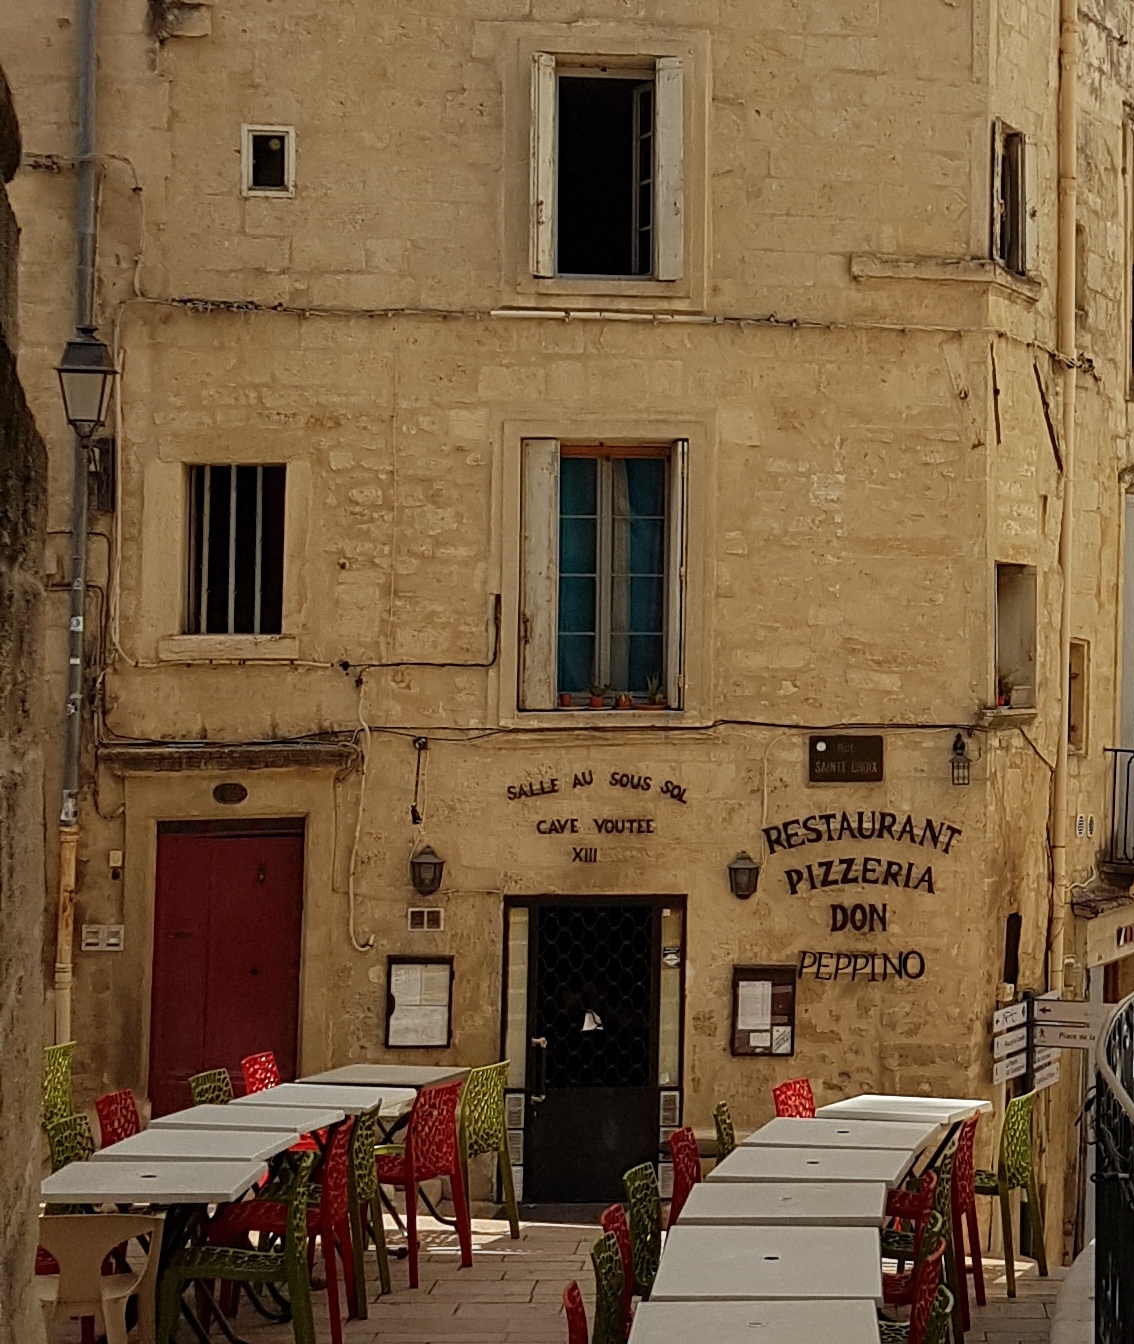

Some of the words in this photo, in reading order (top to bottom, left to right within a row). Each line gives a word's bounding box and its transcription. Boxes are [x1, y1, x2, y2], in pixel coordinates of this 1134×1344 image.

[814, 760, 847, 774] SAINTE
[507, 778, 560, 801] SALLE
[572, 770, 594, 789] AU
[608, 771, 653, 792] SOUS
[660, 780, 688, 805] SOL
[536, 818, 579, 835] CAVE
[593, 818, 655, 834] VOUTEE
[761, 810, 963, 855] RESTAURANT
[572, 847, 598, 863] XIII
[784, 857, 936, 895] PIZZERIA
[830, 903, 888, 933] DON
[798, 950, 926, 983] PEPPINO
